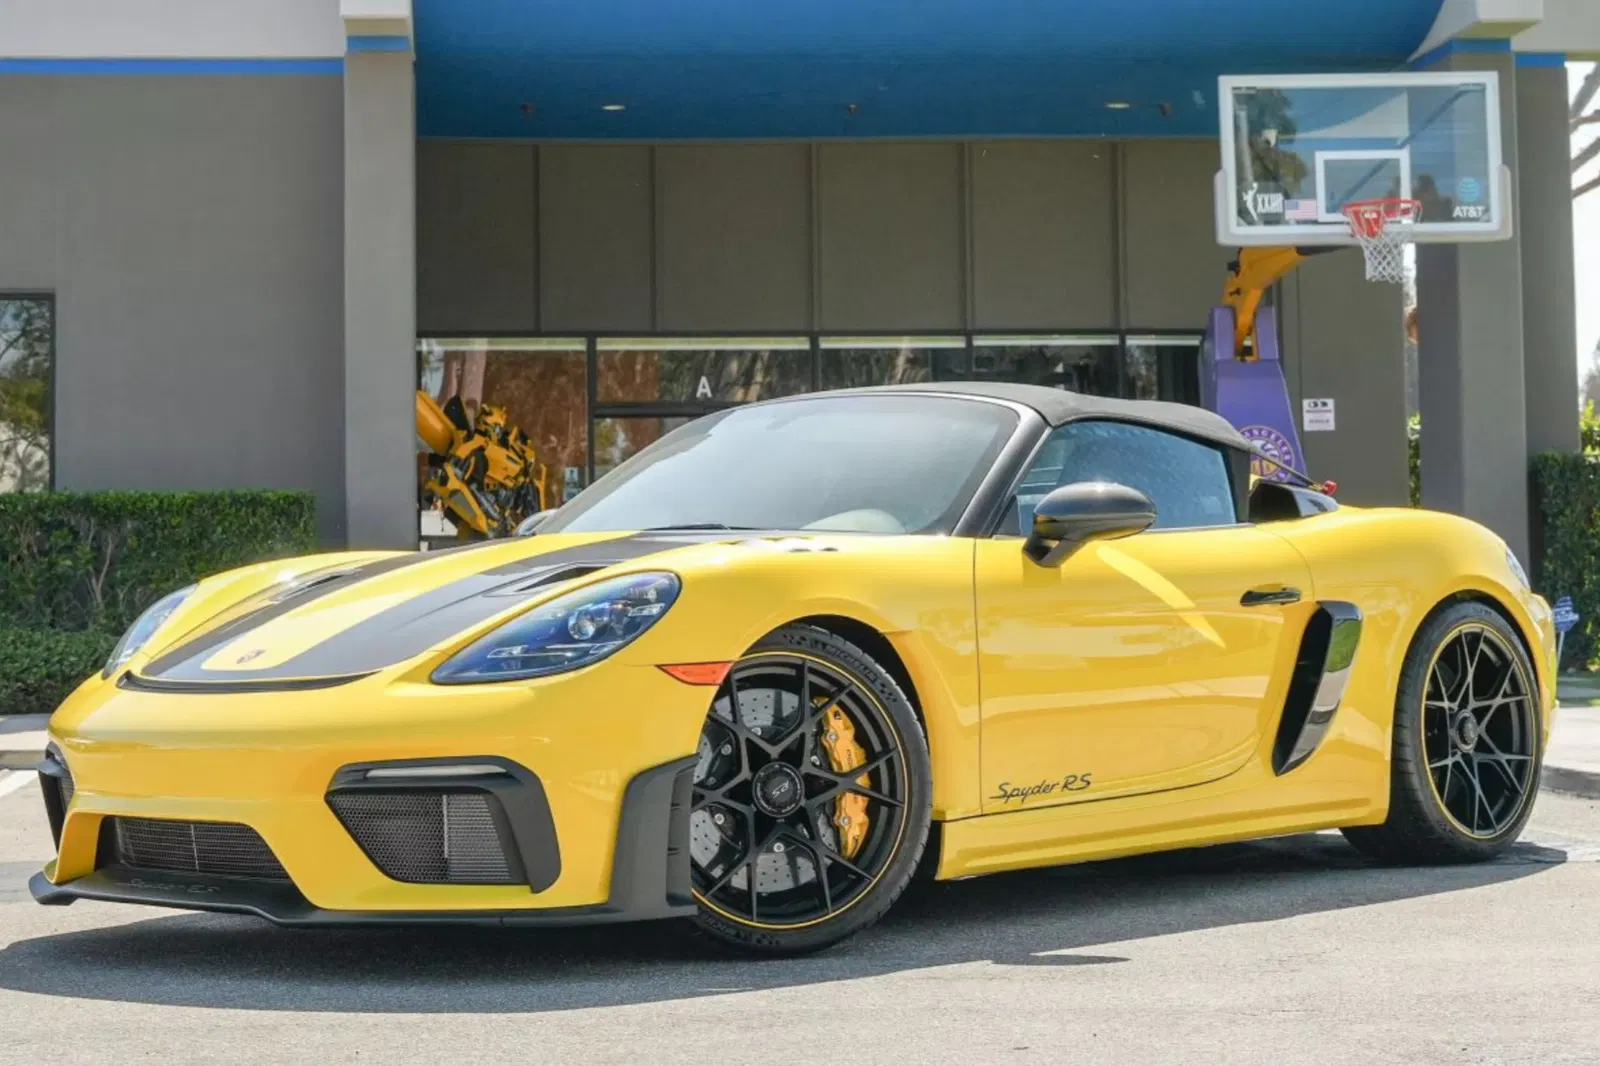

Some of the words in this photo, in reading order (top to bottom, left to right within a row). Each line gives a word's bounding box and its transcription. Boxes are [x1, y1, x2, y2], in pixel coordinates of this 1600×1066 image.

[1452, 205, 1485, 218] AT&T
[696, 375, 712, 398] A
[989, 779, 1059, 804] Spyder
[1061, 772, 1092, 792] RS
